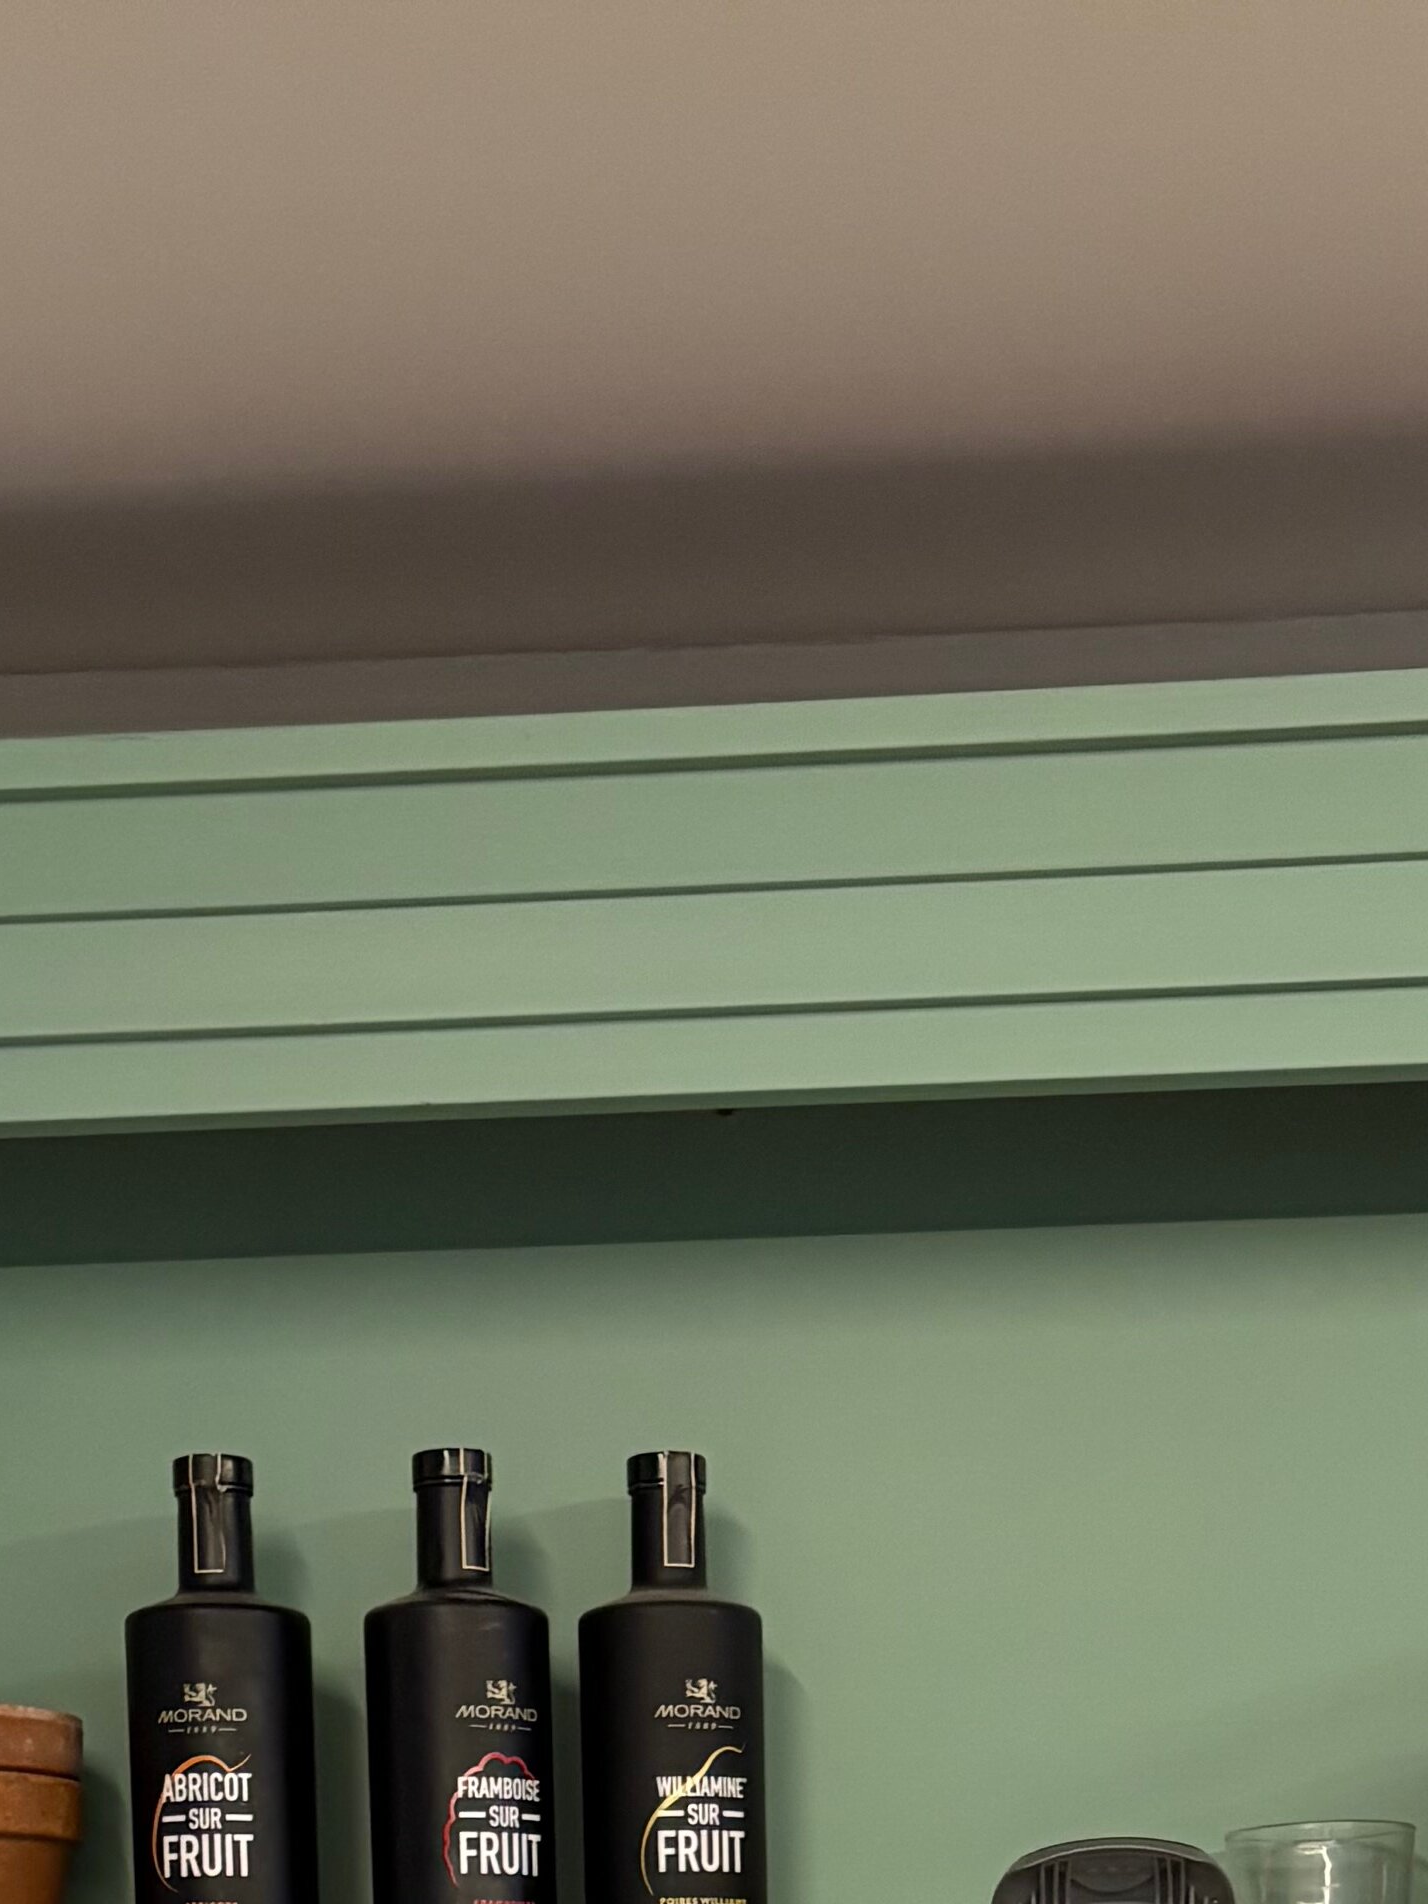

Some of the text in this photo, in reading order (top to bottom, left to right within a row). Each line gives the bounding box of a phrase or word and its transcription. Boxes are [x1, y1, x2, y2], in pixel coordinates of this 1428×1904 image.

[157, 1708, 248, 1724] MORAND
[455, 1704, 538, 1722] MORAND
[654, 1703, 741, 1720] MORAND
[162, 1772, 253, 1803] ABRICOT
[457, 1775, 541, 1802] FRAMBOISE
[188, 1807, 223, 1830] SUR
[488, 1804, 521, 1828] SUR
[687, 1802, 721, 1827] SUR
[162, 1832, 254, 1879] FRUIT
[458, 1830, 542, 1878] FRUIT
[657, 1829, 746, 1874] FRUIT
